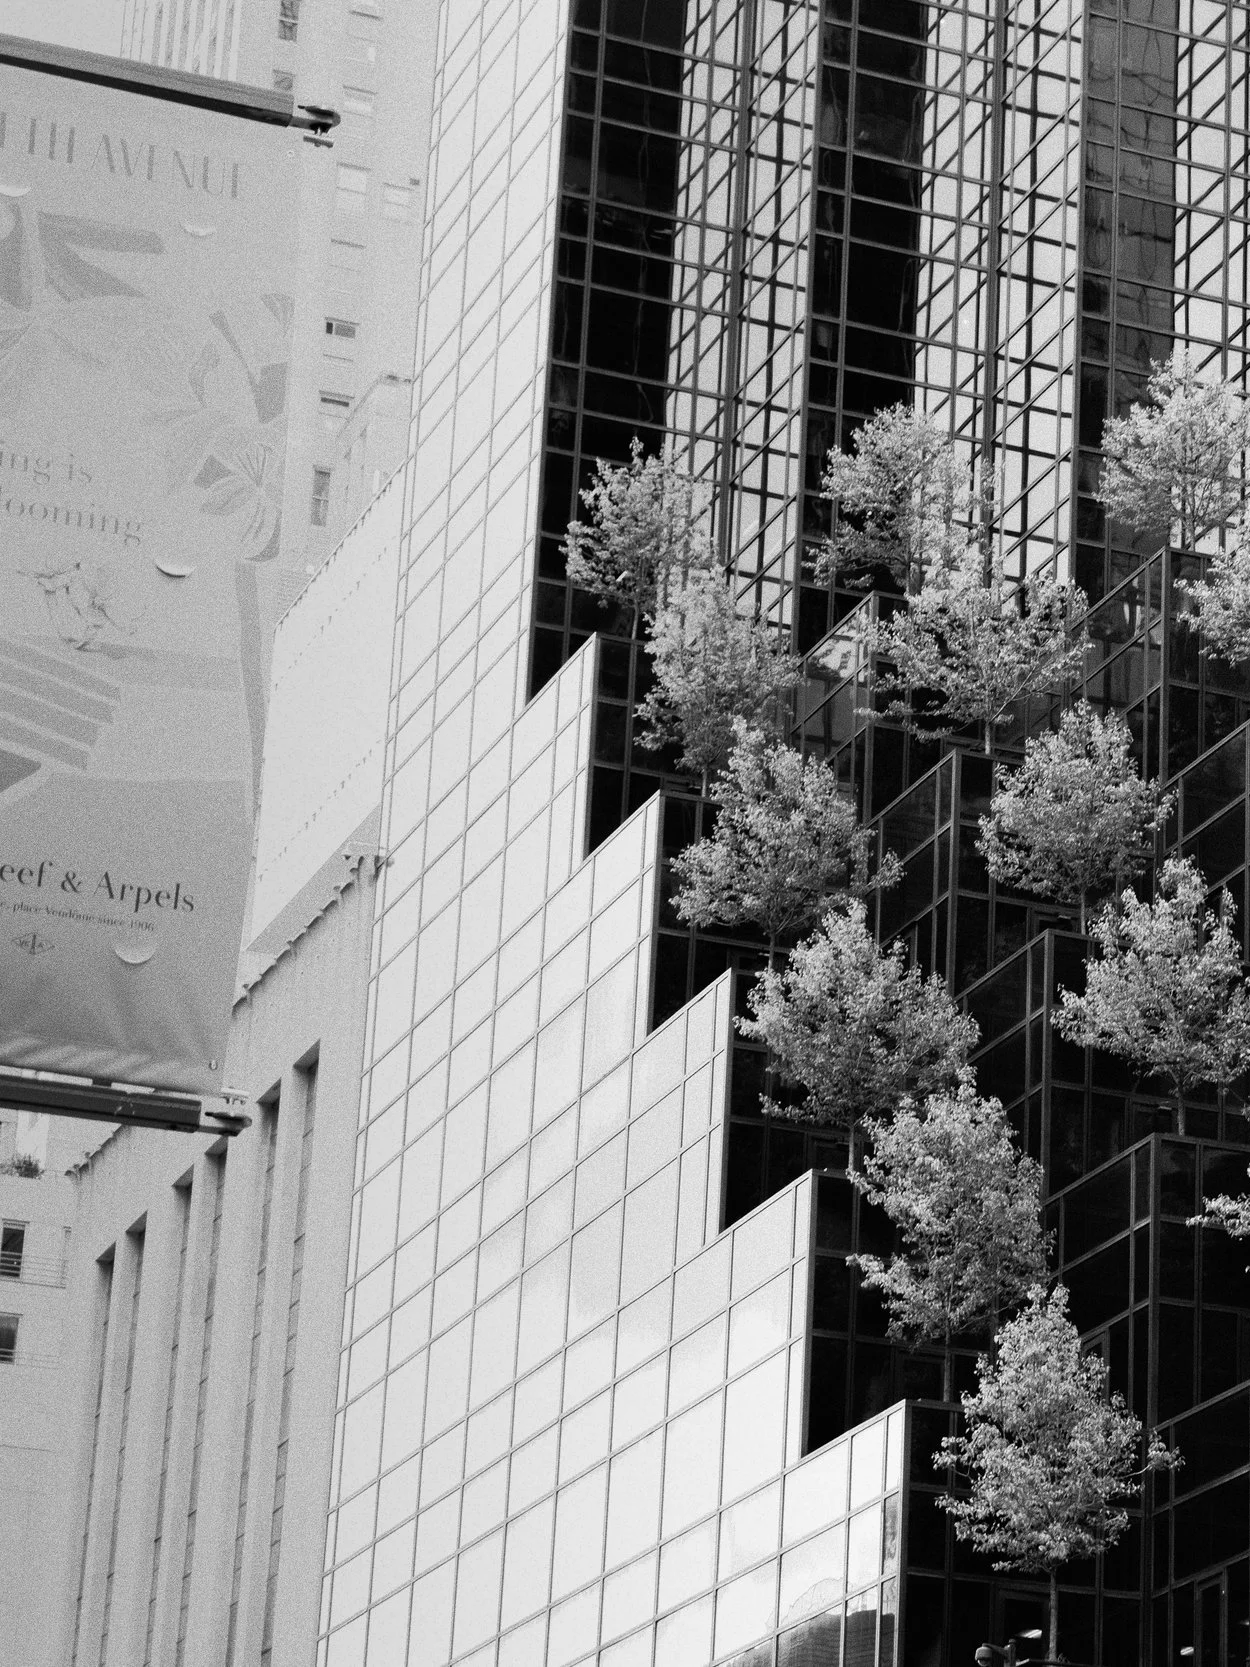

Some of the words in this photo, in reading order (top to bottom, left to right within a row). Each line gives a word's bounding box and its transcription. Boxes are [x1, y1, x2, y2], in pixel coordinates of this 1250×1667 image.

[90, 132, 243, 199] AVENUE
[66, 453, 93, 483] is
[60, 870, 82, 894] &
[93, 870, 194, 913] Arpels
[13, 901, 42, 914] place
[98, 914, 125, 928] since
[130, 918, 155, 933] 1906
